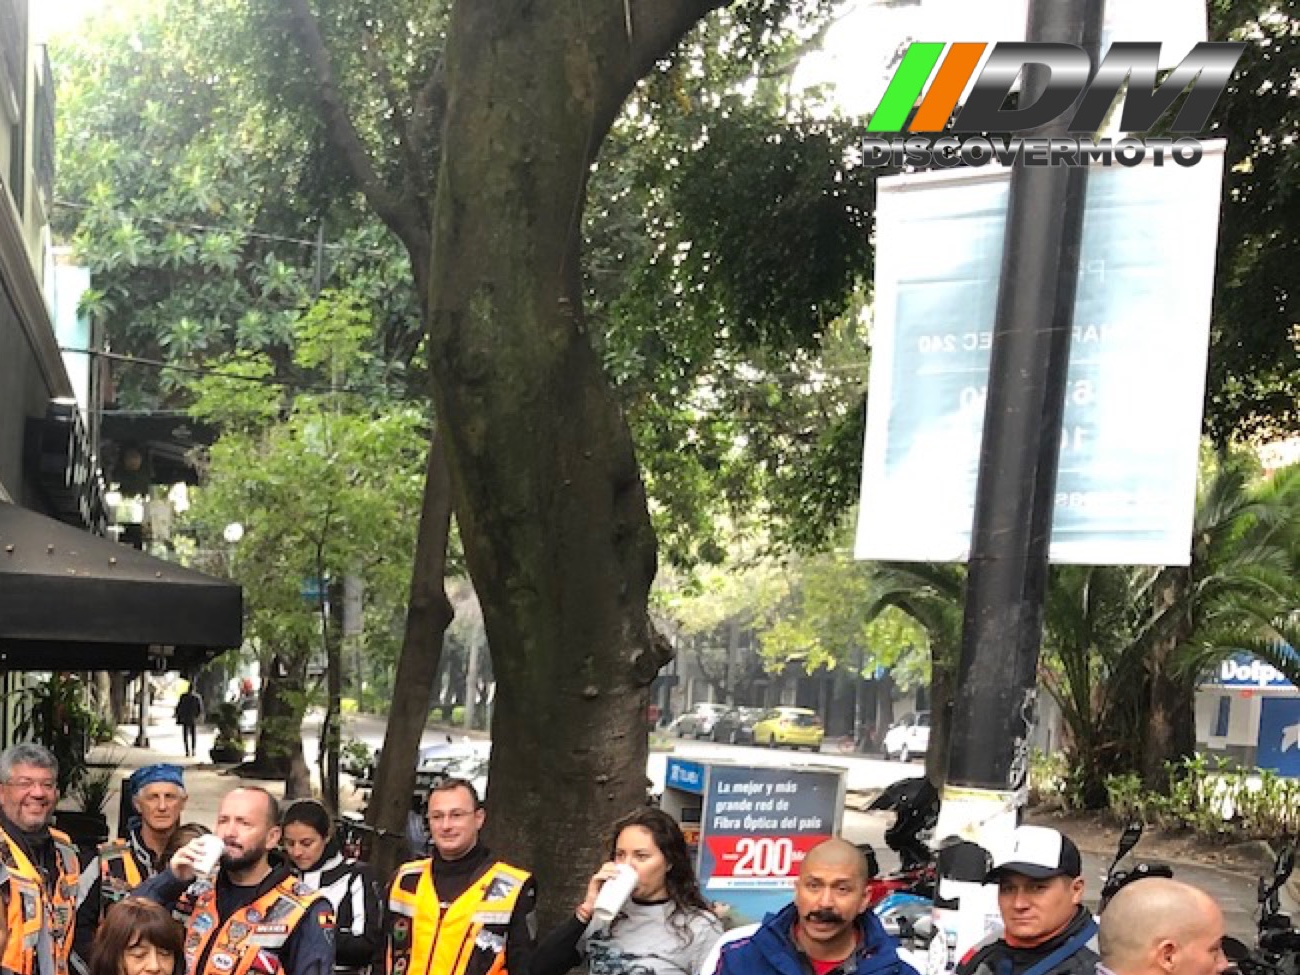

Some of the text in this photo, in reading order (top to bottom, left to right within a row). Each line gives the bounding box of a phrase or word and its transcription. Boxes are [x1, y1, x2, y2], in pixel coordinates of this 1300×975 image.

[717, 780, 797, 796] La mejor y más
[715, 799, 789, 813] grande red de
[713, 814, 823, 831] Fibra Óptica del país
[732, 837, 793, 876] 200
